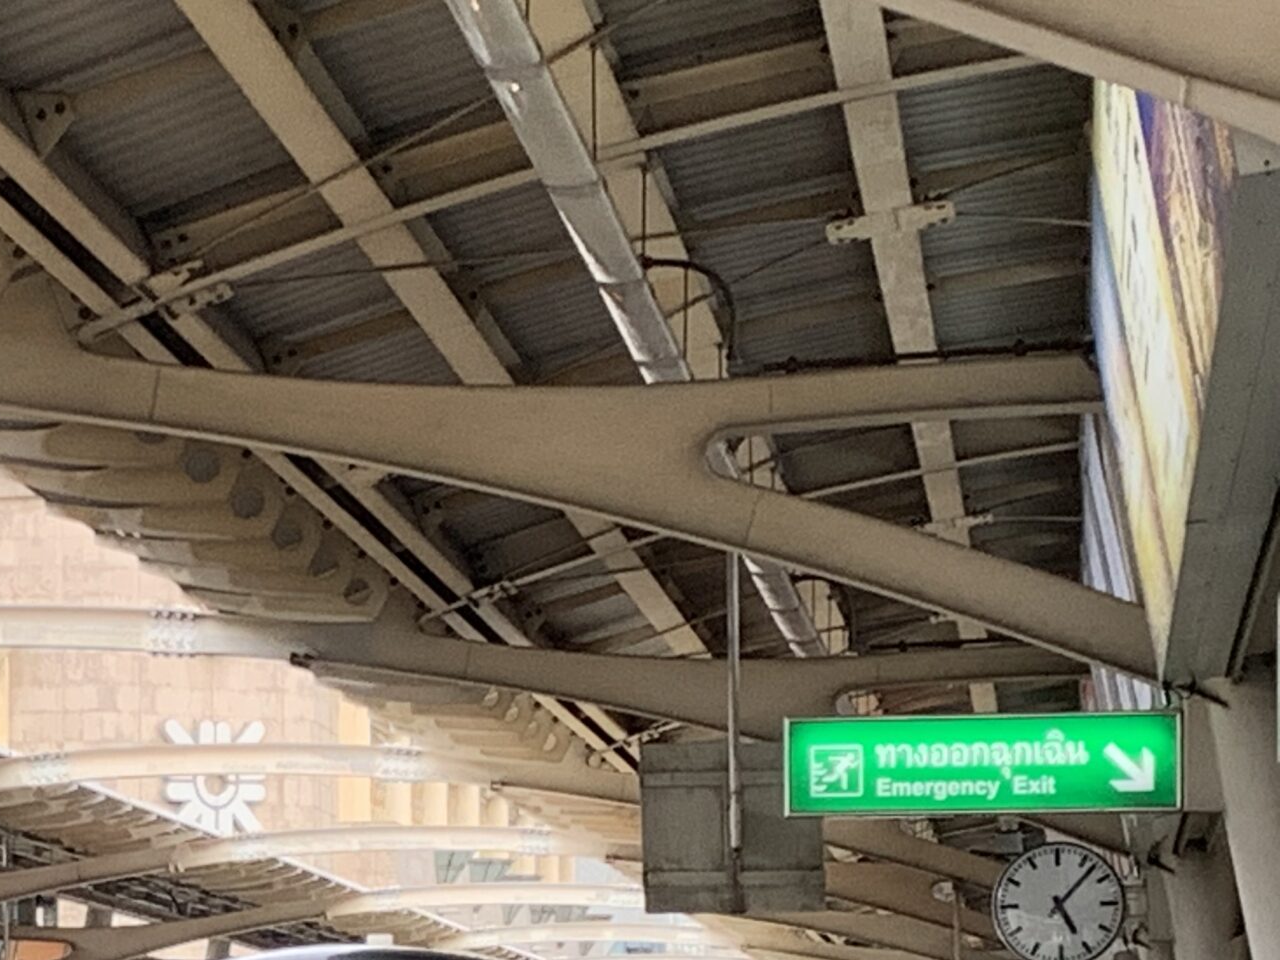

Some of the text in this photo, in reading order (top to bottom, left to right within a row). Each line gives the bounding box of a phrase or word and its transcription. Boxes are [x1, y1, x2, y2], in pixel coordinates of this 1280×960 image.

[874, 728, 1090, 780] ทางออกฉุกเฉิน
[875, 775, 1057, 800] Emergency Exit
